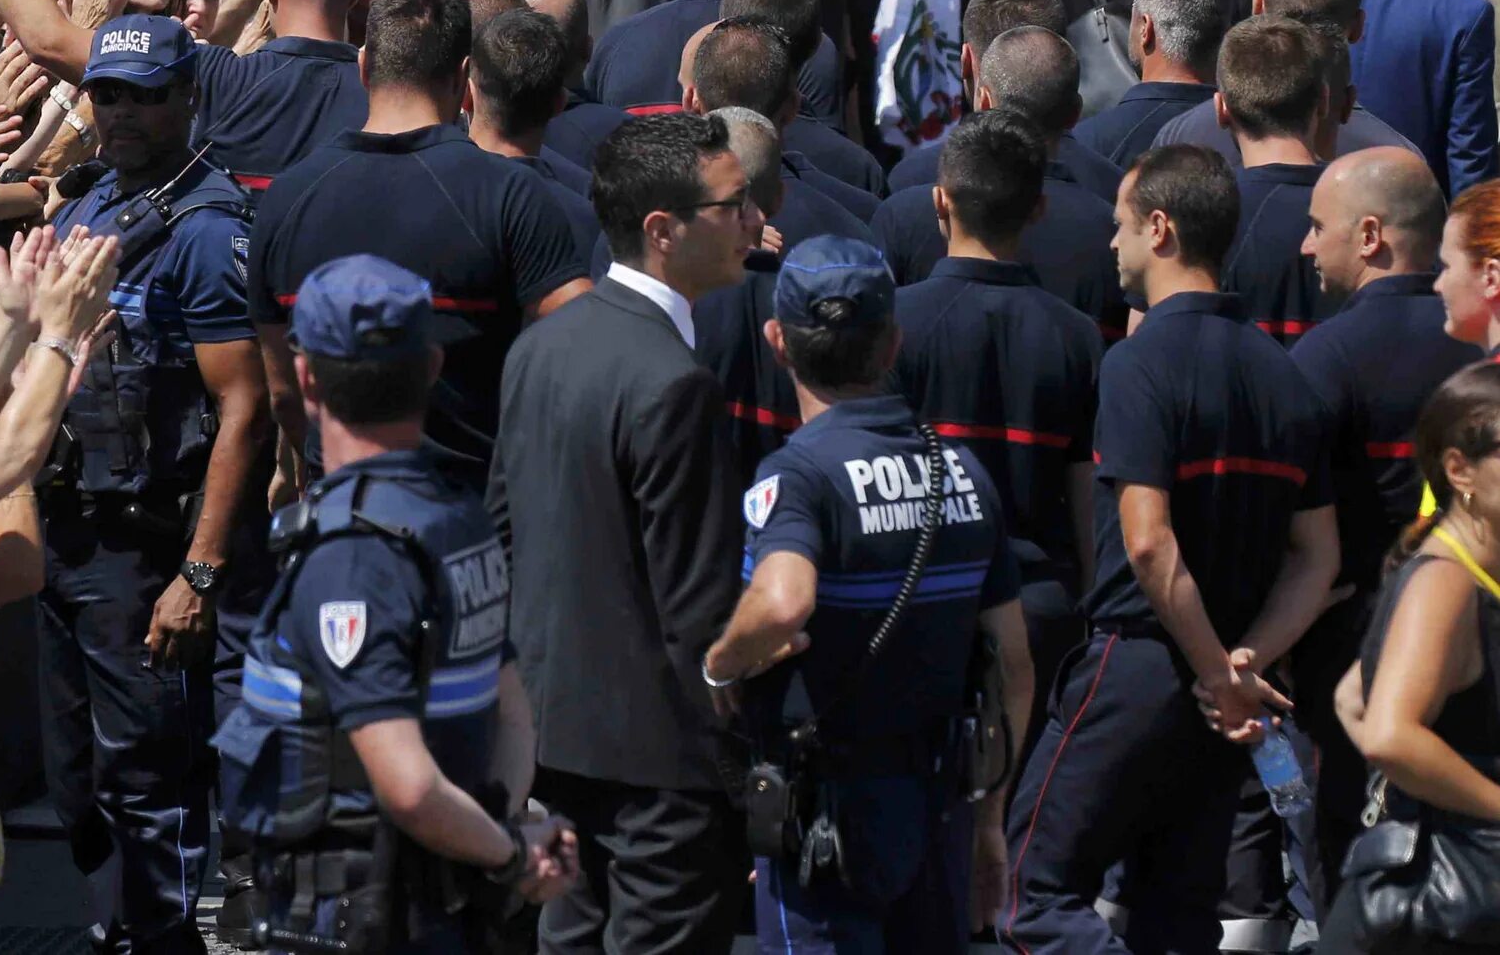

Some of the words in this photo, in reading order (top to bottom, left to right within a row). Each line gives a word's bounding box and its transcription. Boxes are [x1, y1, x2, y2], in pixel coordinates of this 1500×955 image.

[102, 29, 151, 46] POLICE
[100, 43, 149, 55] MUNICIPALE
[858, 493, 984, 534] MUNICALE
